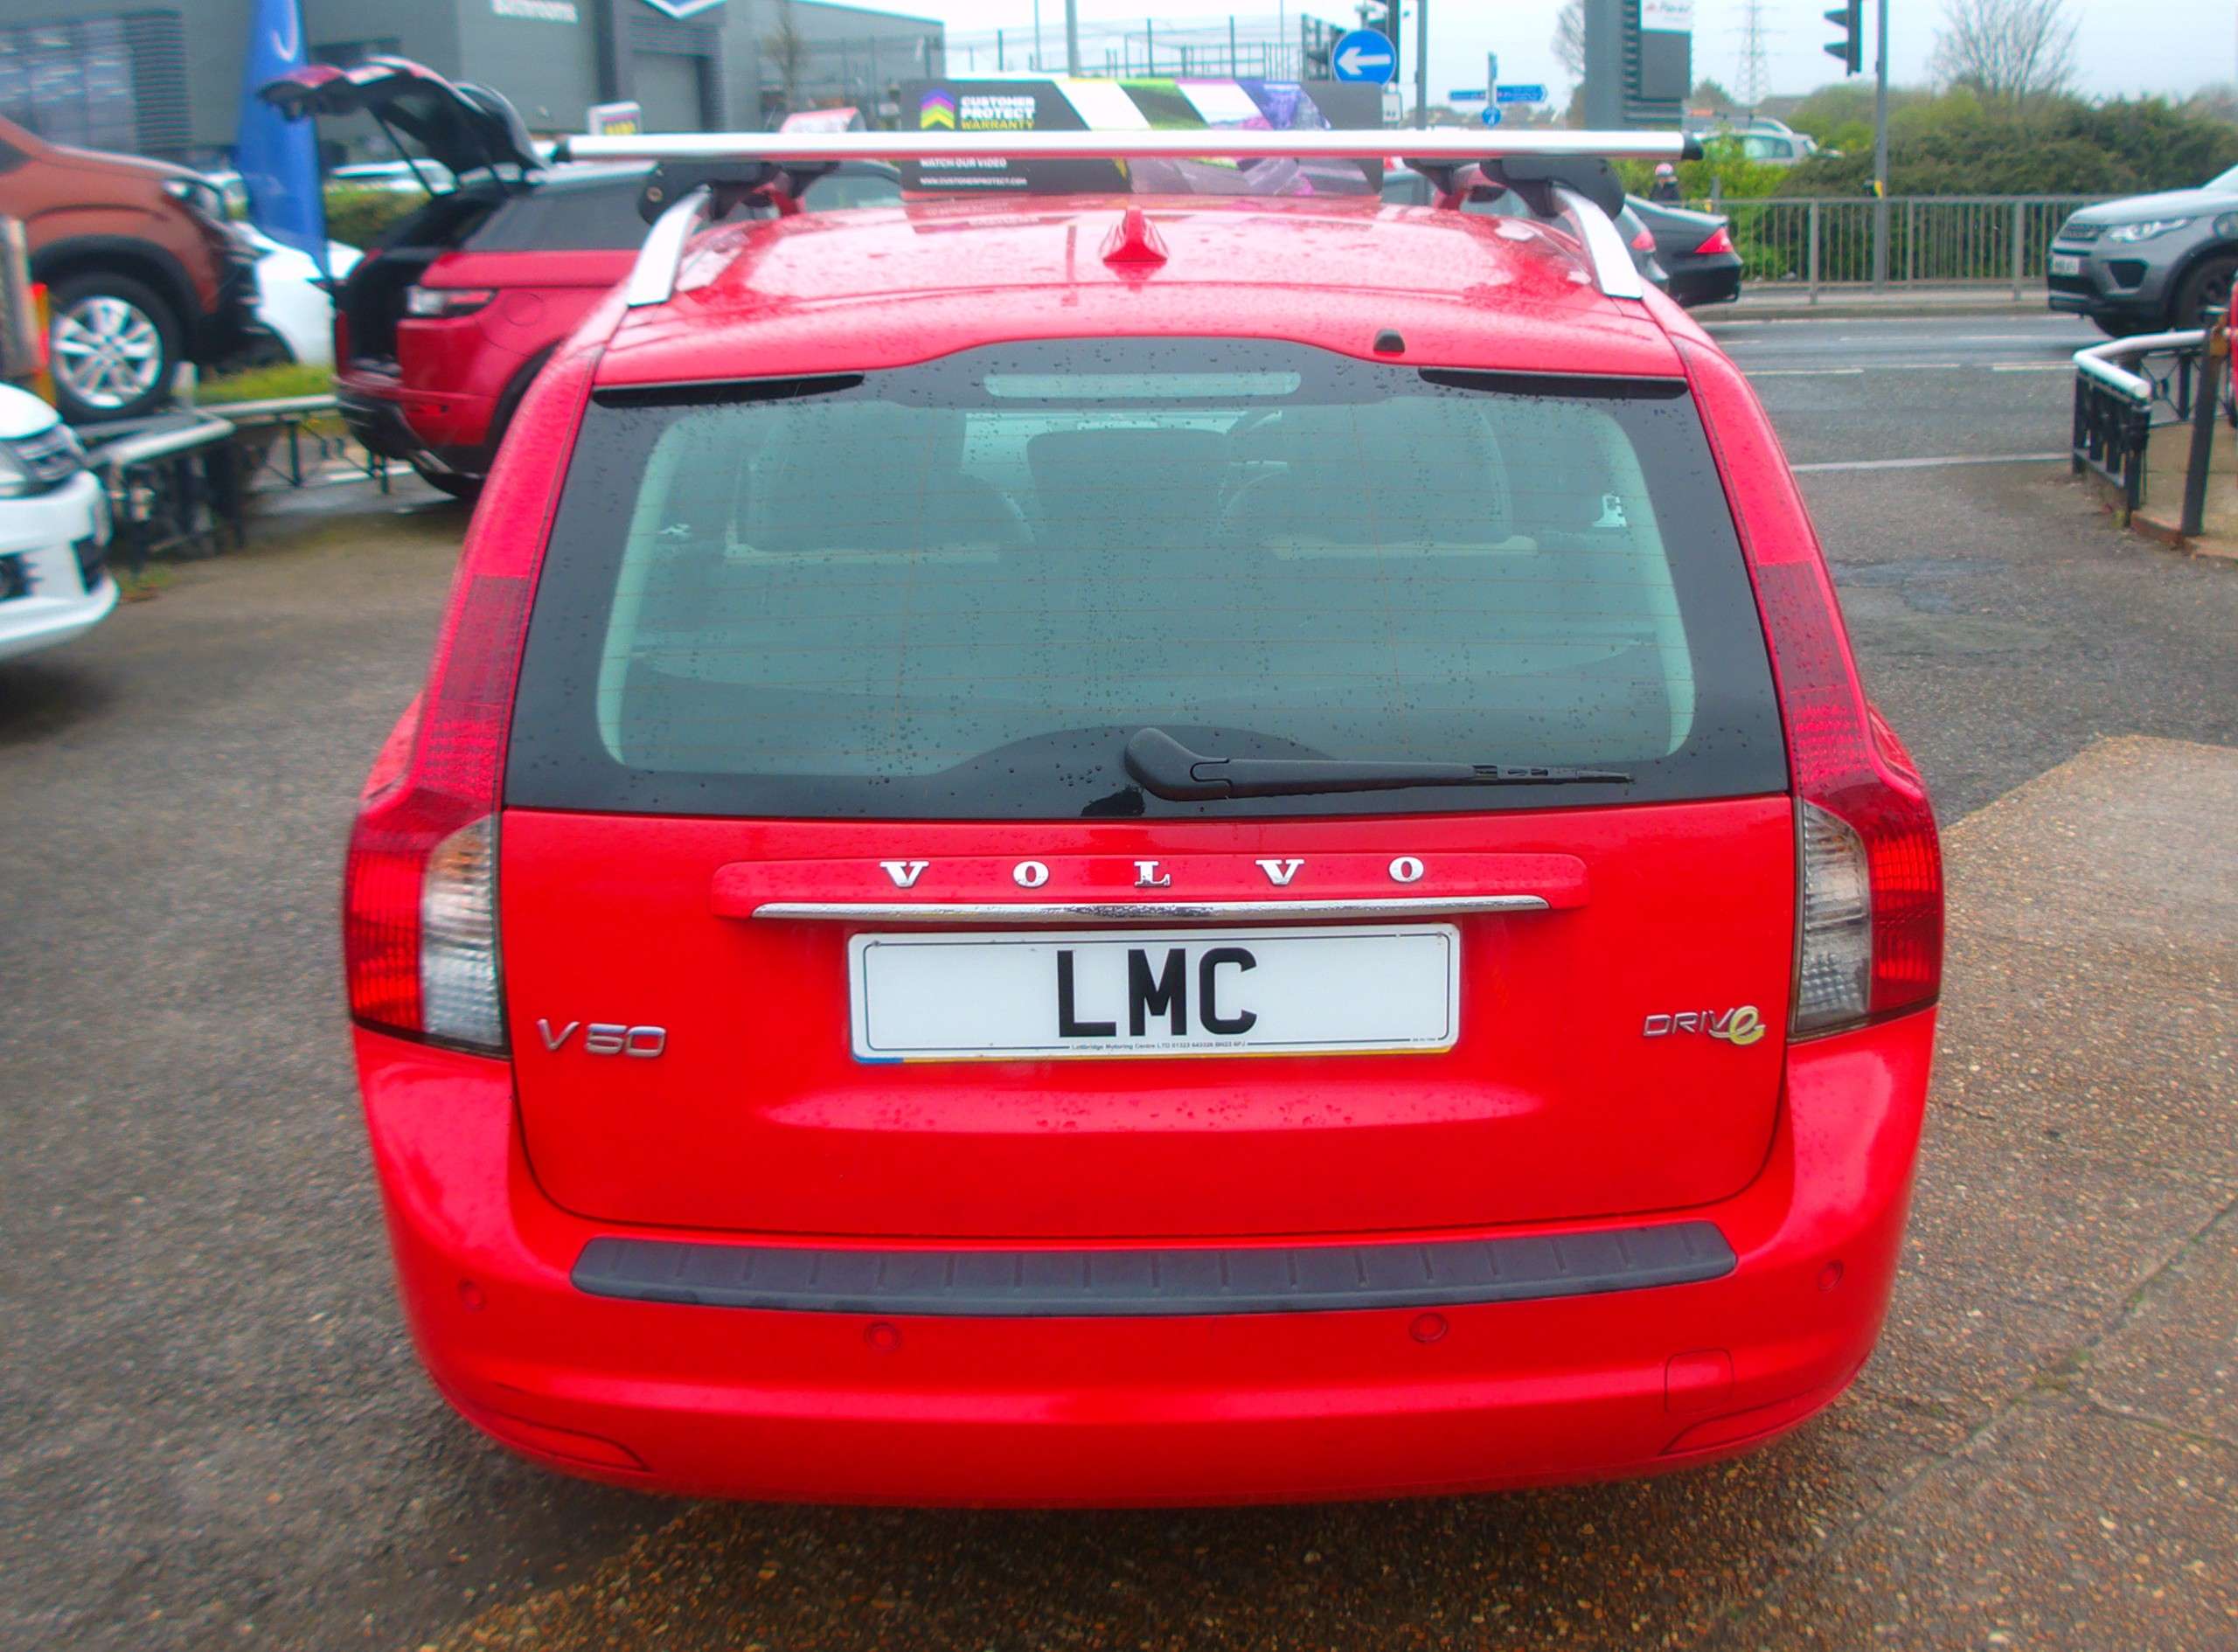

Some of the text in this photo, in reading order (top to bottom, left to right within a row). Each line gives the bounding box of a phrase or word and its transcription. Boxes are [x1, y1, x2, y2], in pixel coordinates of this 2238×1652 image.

[961, 96, 1035, 107] CUSTOMER
[961, 108, 1035, 119] PROTECT
[961, 119, 1034, 129] WARRANTY
[956, 157, 976, 168] OUR
[977, 157, 1007, 168] VIDEO
[879, 857, 1425, 888] VOLVO
[1057, 947, 1257, 1038] LMC
[536, 1018, 667, 1058] V50
